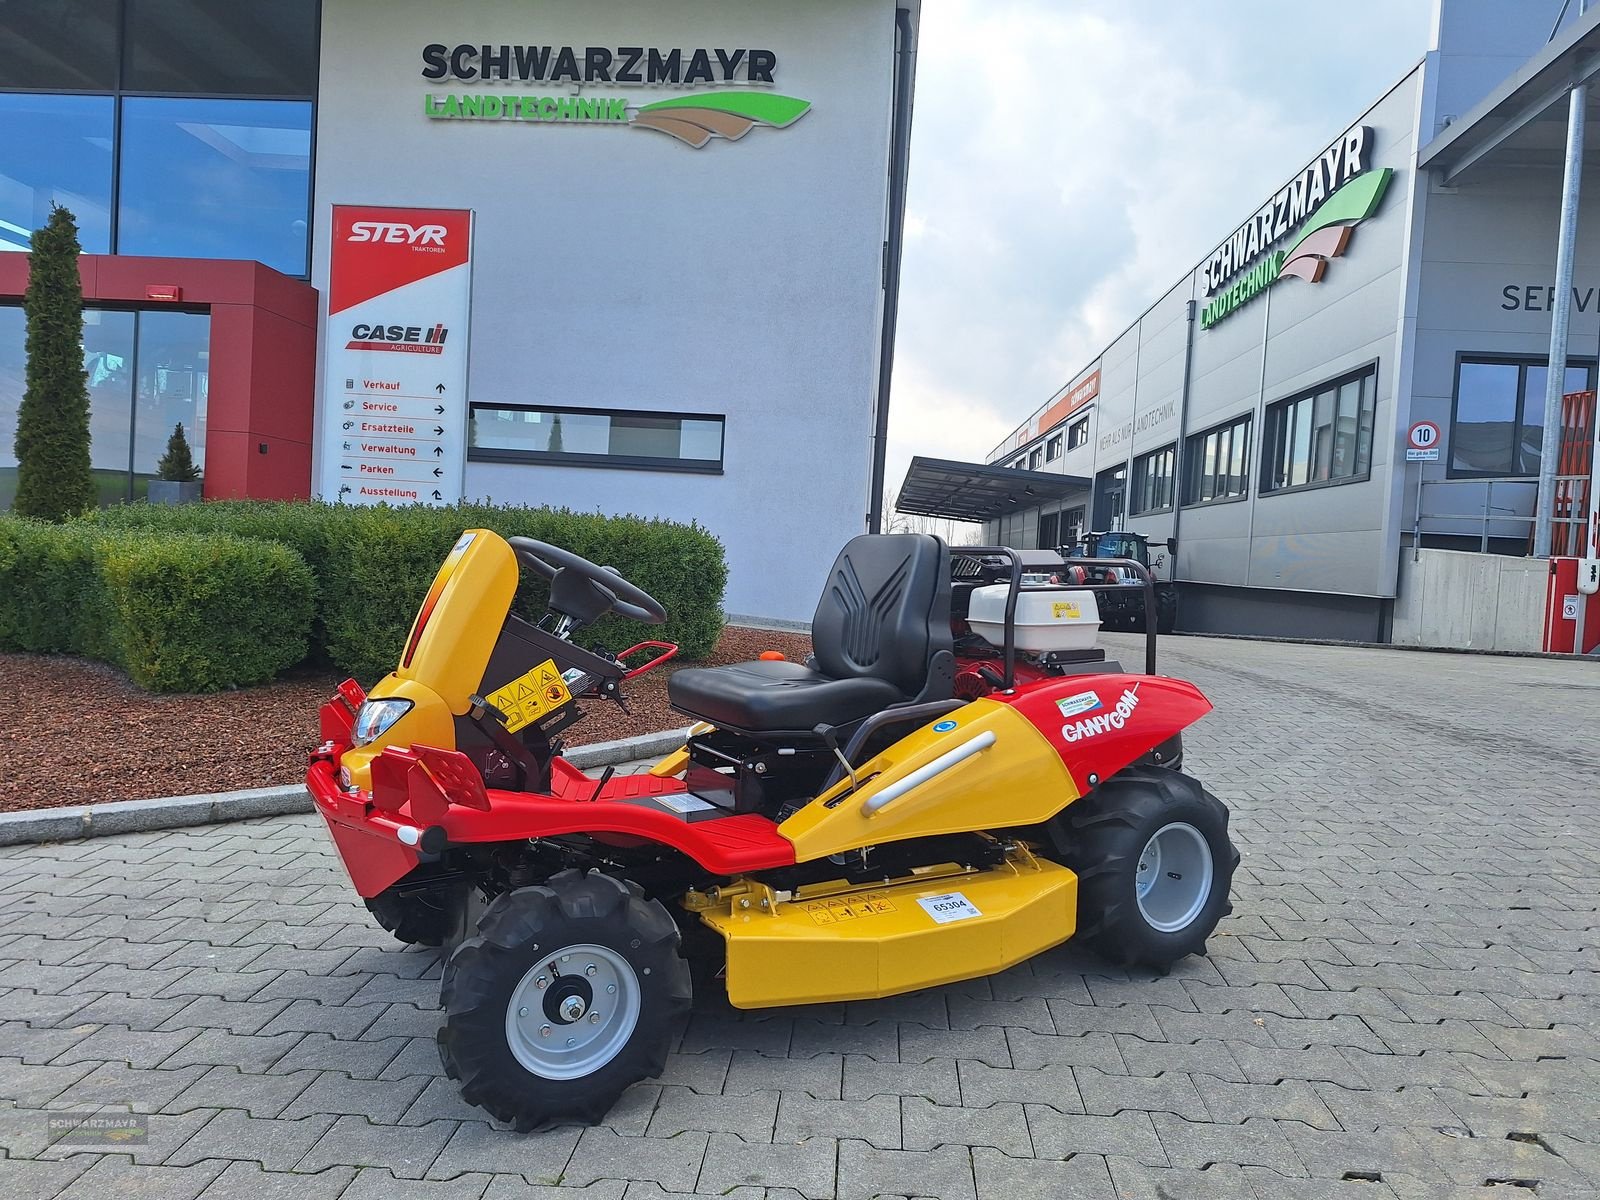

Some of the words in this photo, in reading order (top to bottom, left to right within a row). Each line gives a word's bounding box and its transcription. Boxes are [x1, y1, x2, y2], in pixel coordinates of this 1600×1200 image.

[421, 44, 777, 84] SCHWARZMAYR
[425, 94, 629, 121] LANDTECHNIK
[1202, 126, 1374, 297] SCHWARZMAYR
[347, 221, 448, 246] STEYR
[1200, 250, 1285, 330] LANDTECHNIK
[352, 324, 421, 342] CASE
[390, 344, 441, 354] AGRICULTURE
[363, 380, 401, 390] Verkauf
[362, 401, 398, 412] Service
[361, 422, 415, 434] Ersatzteile
[1417, 428, 1430, 442] 10
[360, 443, 416, 456] Verwaltung
[360, 464, 394, 474] Parken
[360, 486, 417, 498] Ausstellung
[1062, 682, 1140, 744] CANYCOM
[933, 900, 967, 912] 65304
